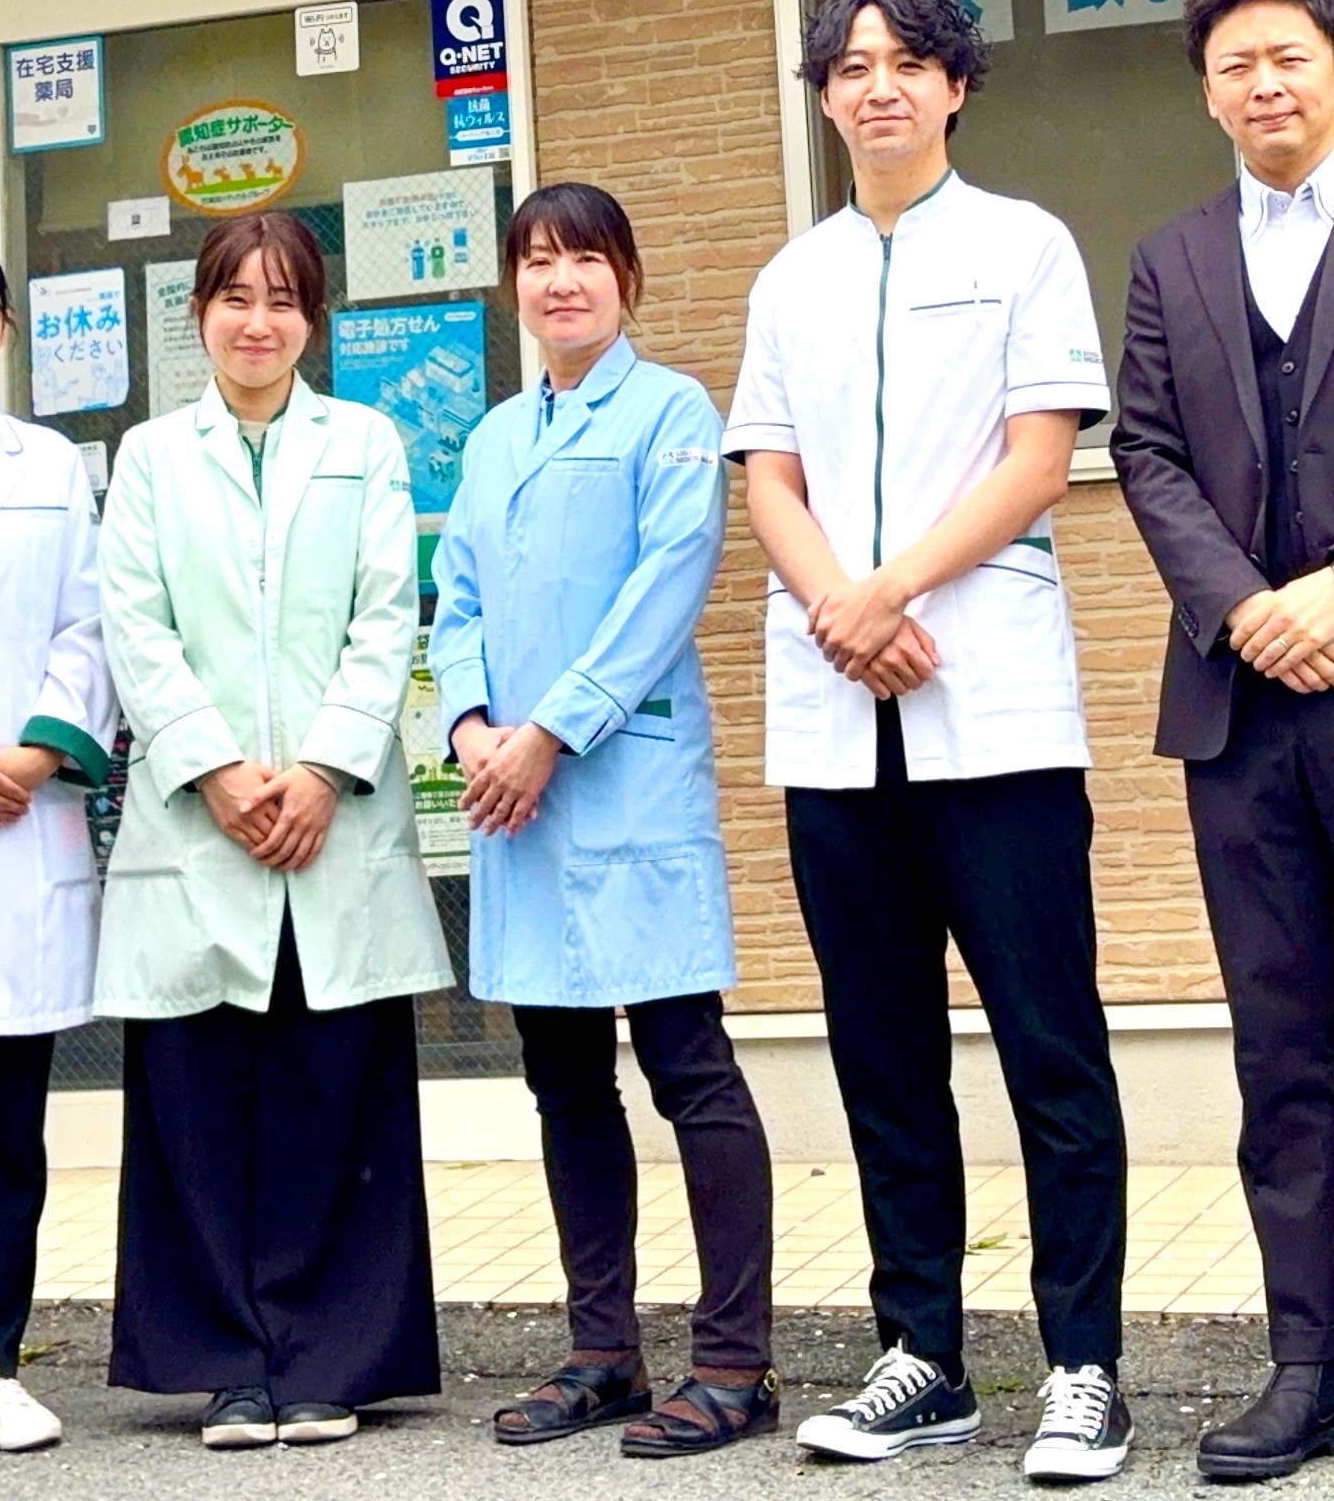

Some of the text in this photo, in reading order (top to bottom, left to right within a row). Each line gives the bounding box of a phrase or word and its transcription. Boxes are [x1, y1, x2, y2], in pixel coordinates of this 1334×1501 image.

[16, 48, 95, 79] 在宅支援
[449, 61, 496, 75] SECURITY
[34, 78, 74, 102] 薬局
[177, 114, 294, 149] 認知症サポーター
[36, 303, 121, 340] お休み
[338, 314, 441, 339] 電子処方せん
[53, 339, 123, 363] ください
